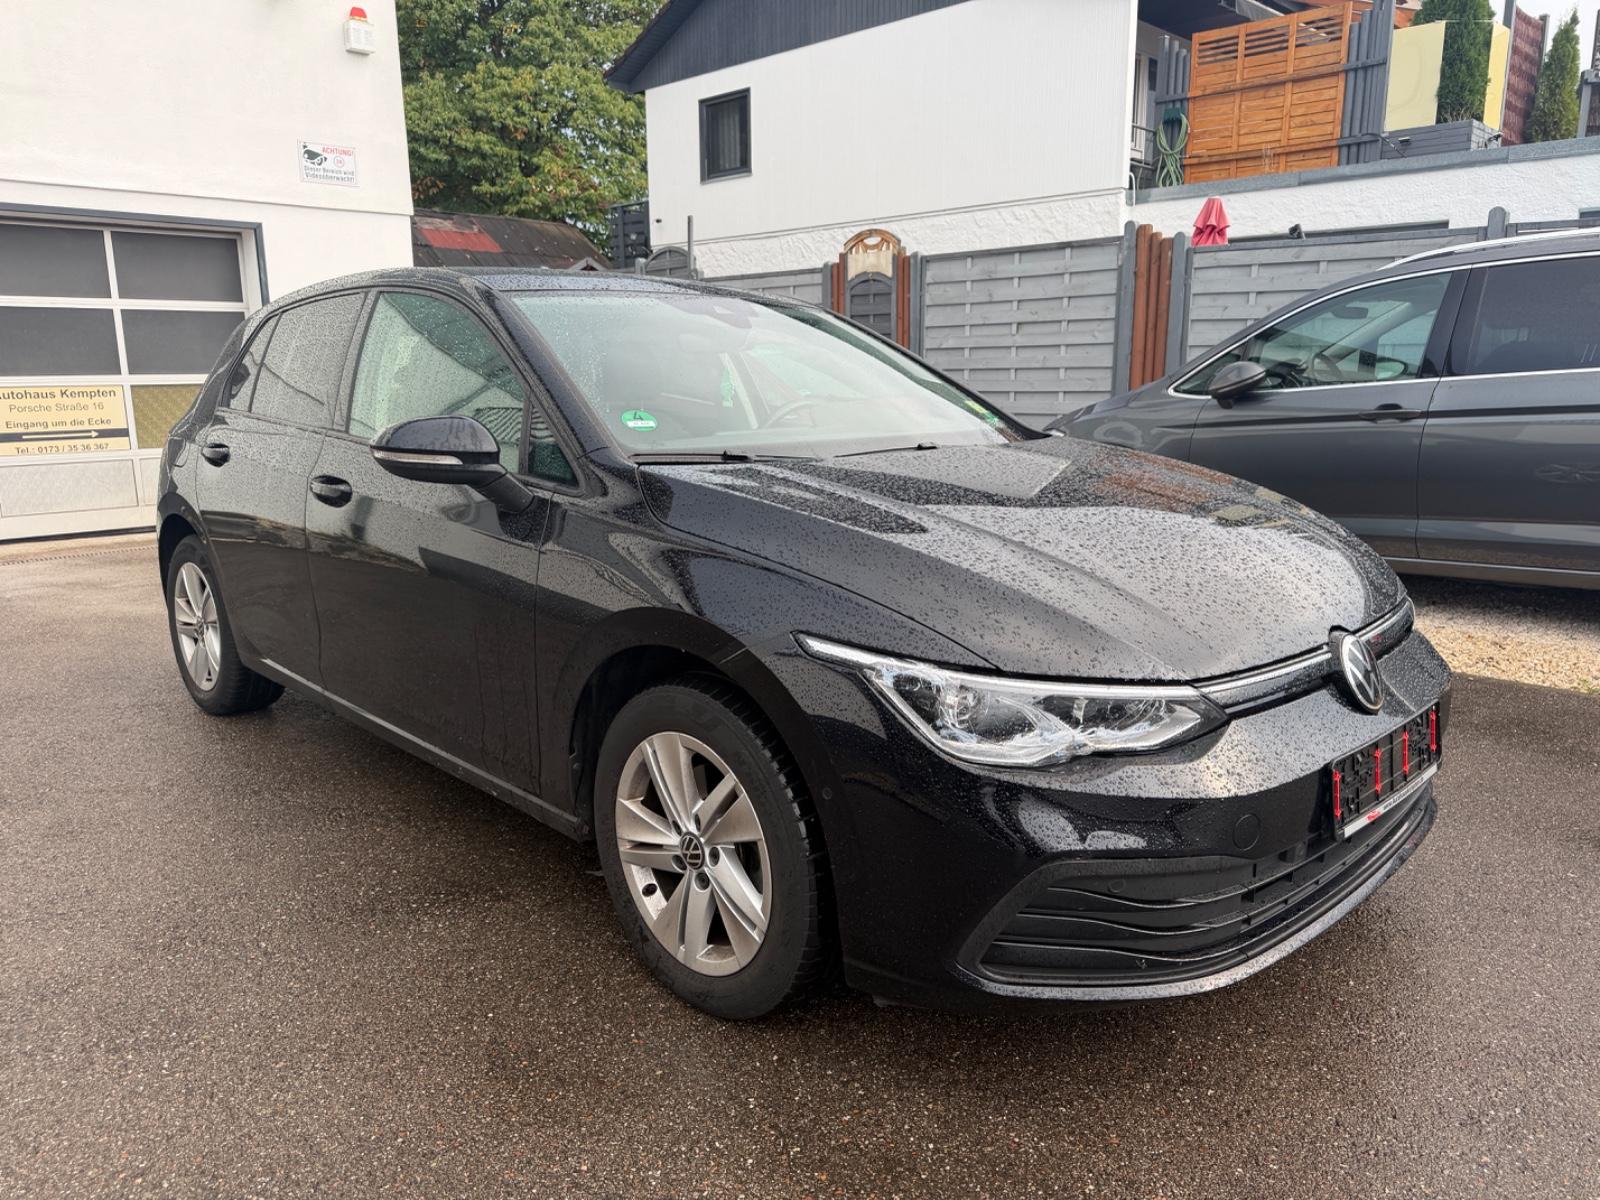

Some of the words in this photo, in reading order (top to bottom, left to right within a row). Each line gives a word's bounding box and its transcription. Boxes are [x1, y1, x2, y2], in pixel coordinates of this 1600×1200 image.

[0, 390, 56, 400] utohaus
[60, 389, 116, 400] Kempten
[9, 403, 52, 413] Porsche
[55, 402, 89, 411] Straße
[6, 420, 48, 430] Eingang
[70, 418, 85, 426] die
[88, 417, 111, 426] Ecke
[37, 445, 60, 453] 0173
